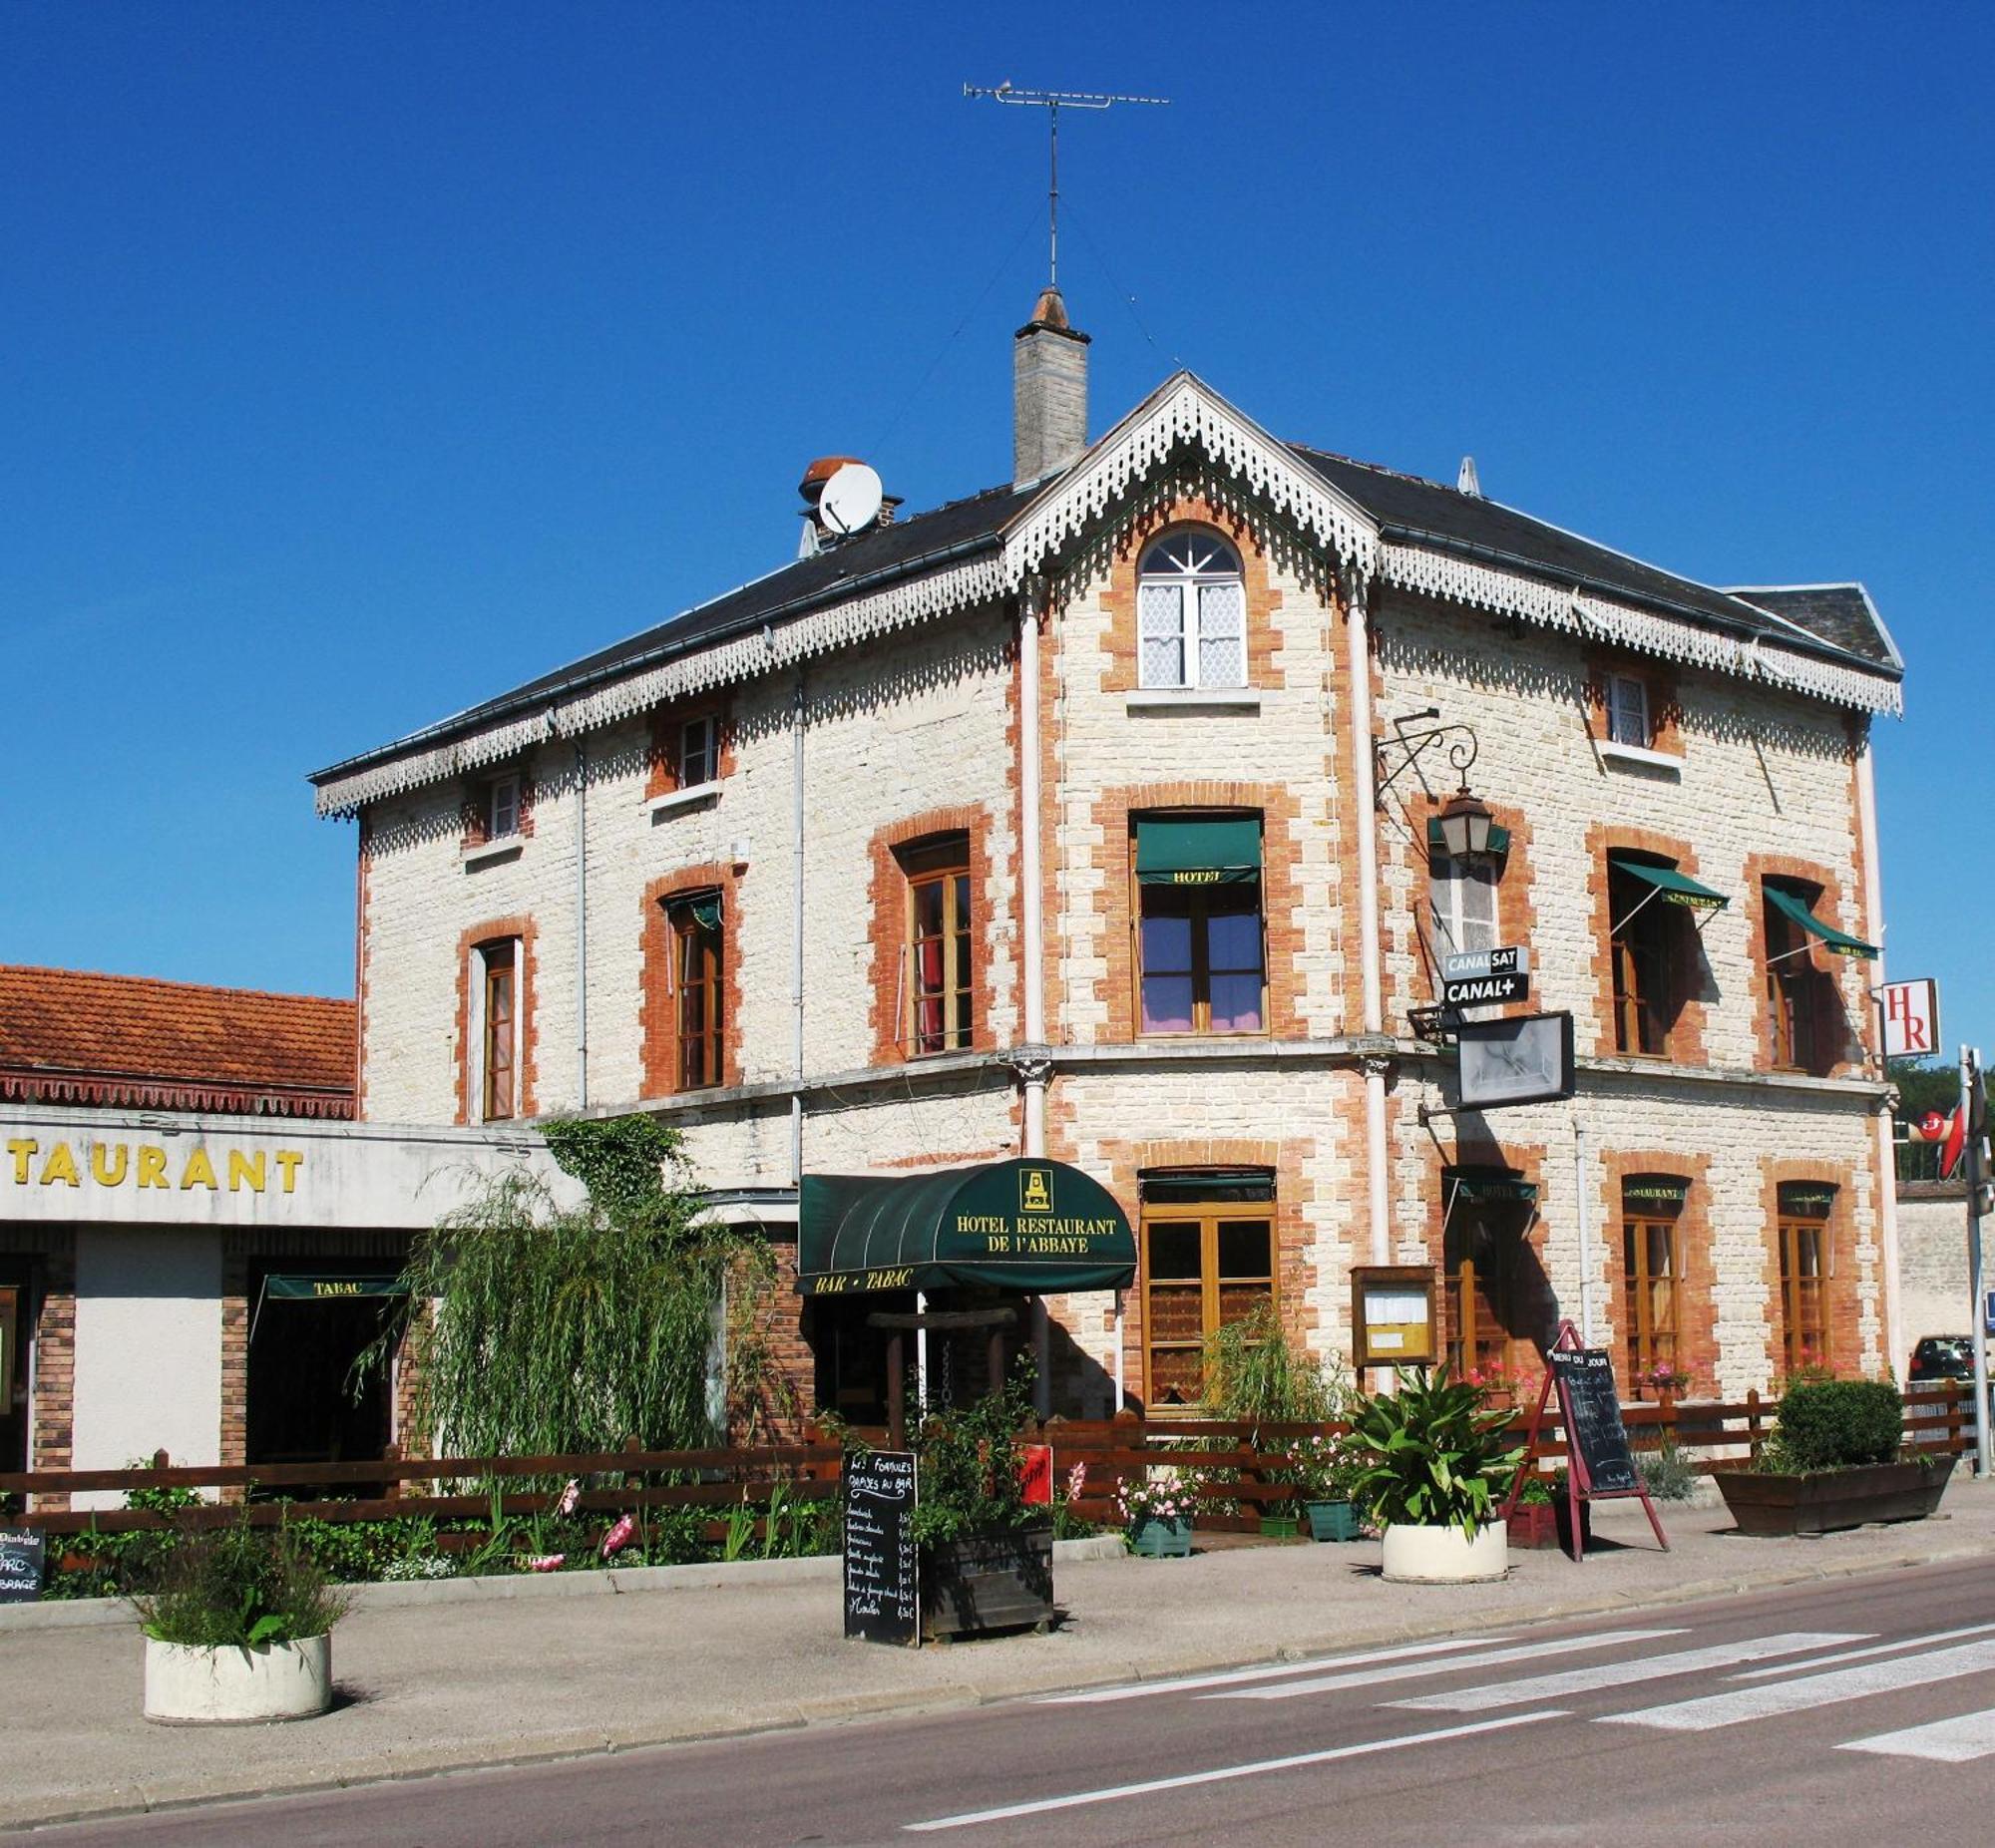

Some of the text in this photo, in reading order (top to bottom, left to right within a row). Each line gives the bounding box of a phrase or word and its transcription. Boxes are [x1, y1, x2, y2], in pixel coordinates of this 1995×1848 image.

[1447, 978, 1514, 1002] CANAL+
[7, 1138, 304, 1194] TAURANT
[957, 1216, 1117, 1236] HOTEL RESTAURANT
[989, 1236, 1010, 1253] DE
[313, 1282, 363, 1295] TABAC
[815, 1268, 915, 1294] BAR TABAC
